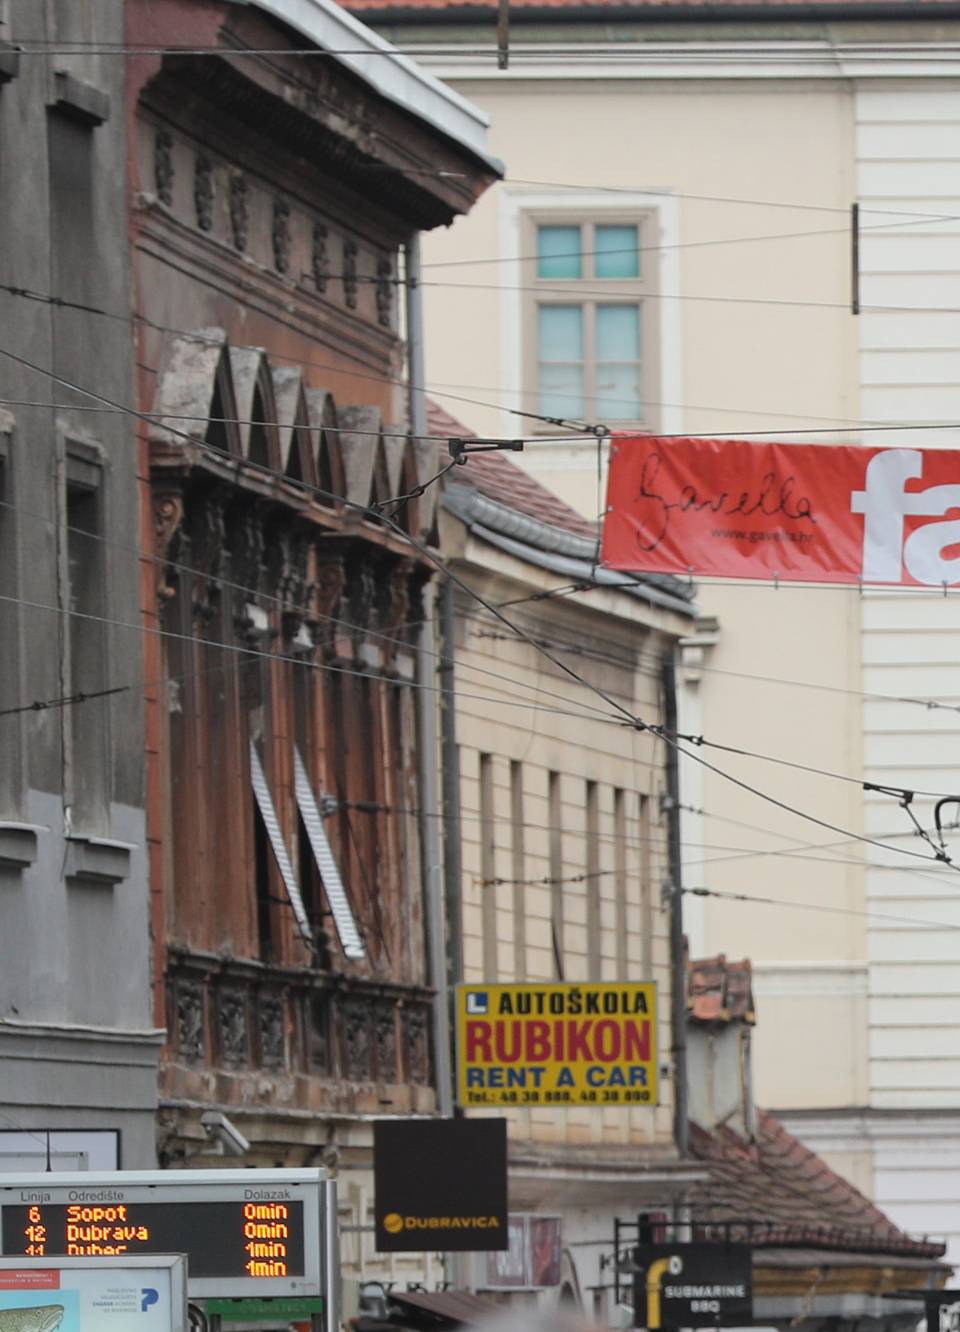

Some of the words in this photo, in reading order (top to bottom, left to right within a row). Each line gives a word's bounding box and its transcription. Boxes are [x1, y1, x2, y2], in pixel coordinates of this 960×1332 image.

[499, 987, 648, 1015] AUTOŠKOLA
[466, 1019, 652, 1063] RUBIKON
[467, 1066, 547, 1088] RENT
[556, 1067, 575, 1088] A
[586, 1066, 649, 1088] CAR
[20, 1190, 51, 1203] Linija
[68, 1189, 125, 1201] Odredište
[244, 1189, 291, 1200] Dolazak
[28, 1205, 41, 1223] 6
[66, 1205, 127, 1222] Sopot
[243, 1203, 288, 1219] 0min
[404, 1216, 500, 1229] DUBRAVICA
[25, 1225, 46, 1242] 12
[66, 1224, 149, 1241] Dubrava
[243, 1222, 288, 1238] 0min
[244, 1241, 287, 1257] 1min
[244, 1260, 287, 1276] 1min
[665, 1285, 746, 1298] SUBMARINE
